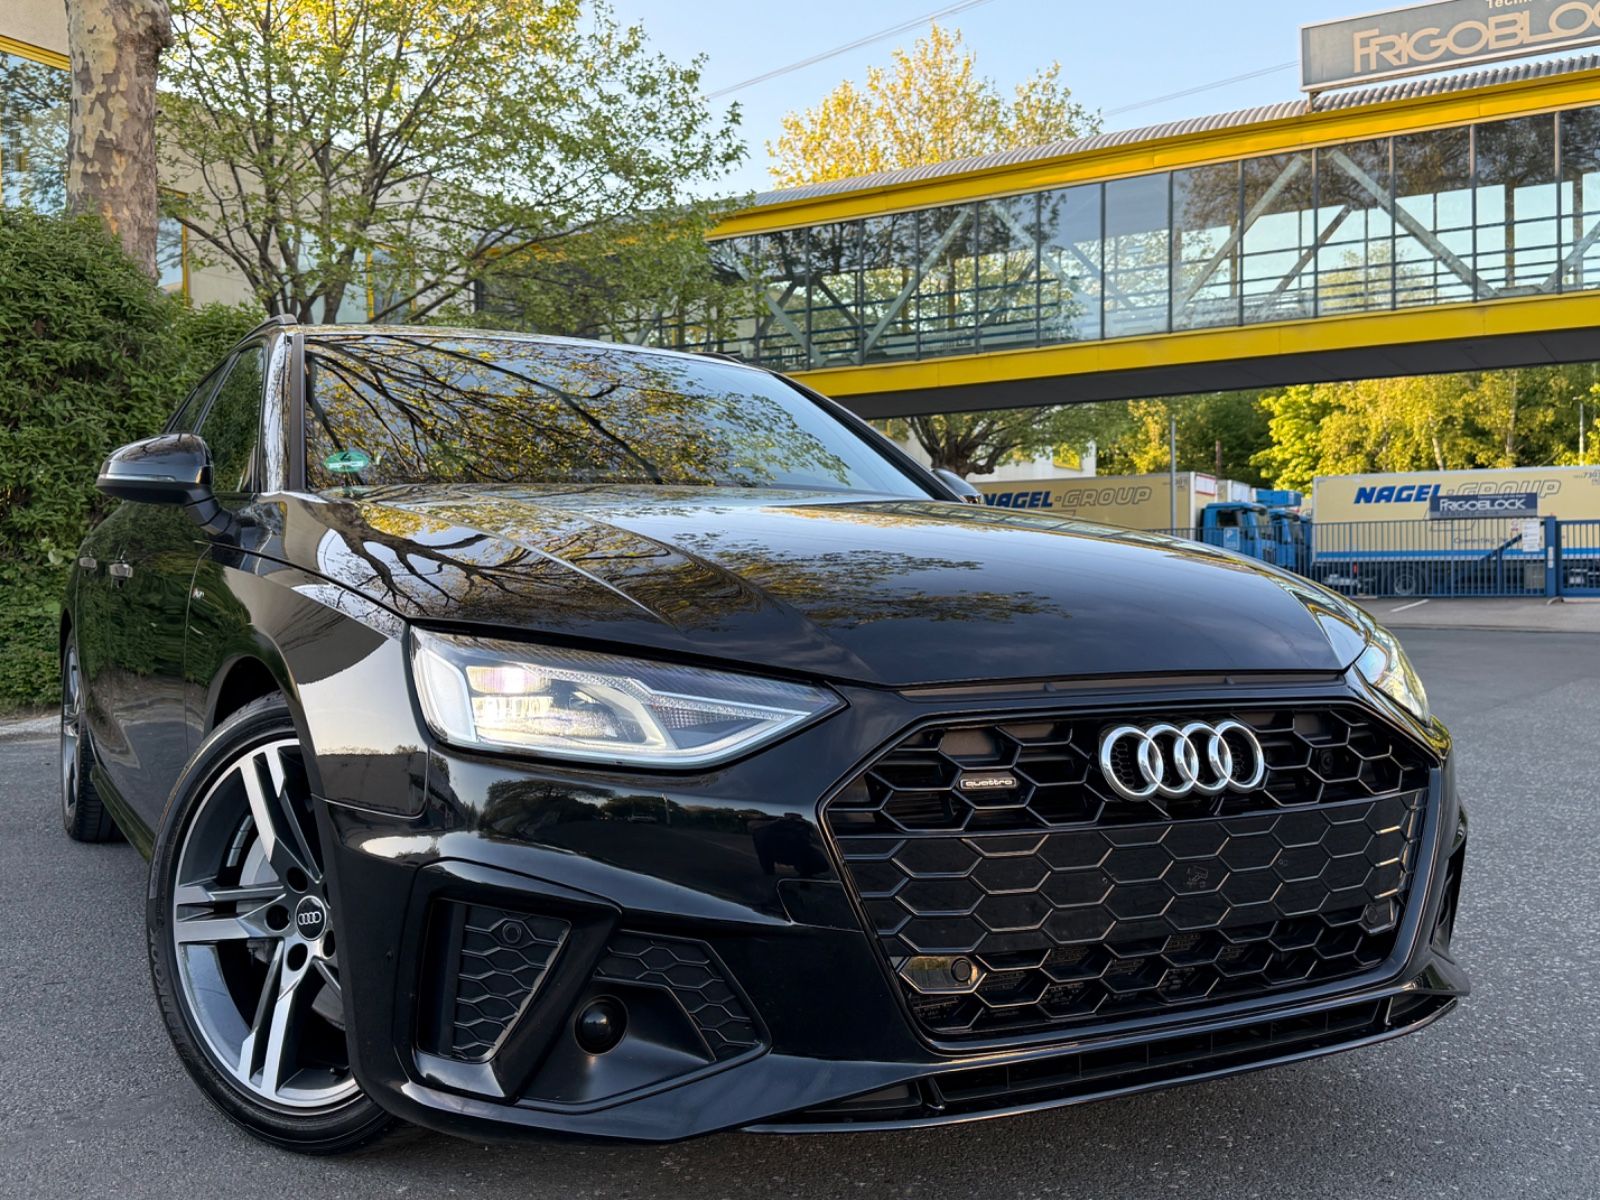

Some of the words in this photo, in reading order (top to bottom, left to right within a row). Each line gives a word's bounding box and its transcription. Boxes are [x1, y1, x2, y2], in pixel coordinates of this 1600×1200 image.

[1353, 1, 1600, 73] FRIGOBLO
[1440, 499, 1526, 511] FRIGOBLOCK
[965, 779, 1013, 788] quattro
